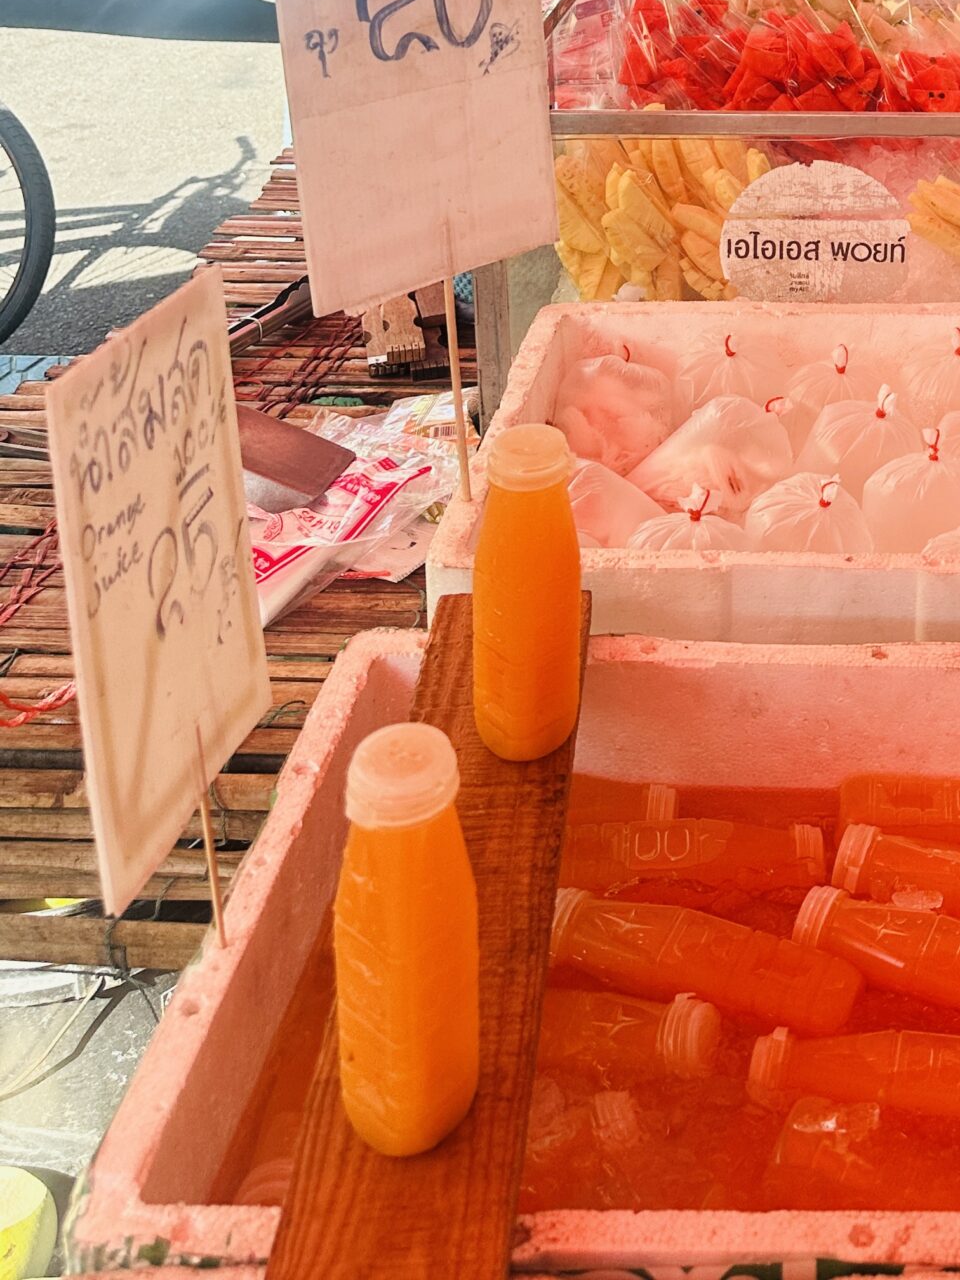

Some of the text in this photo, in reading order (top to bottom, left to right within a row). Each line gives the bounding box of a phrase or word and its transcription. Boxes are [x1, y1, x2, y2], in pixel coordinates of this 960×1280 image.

[727, 231, 820, 261] เอไอเอส
[81, 493, 146, 562] Orange
[147, 486, 218, 642] 25
[87, 540, 144, 619] juice
